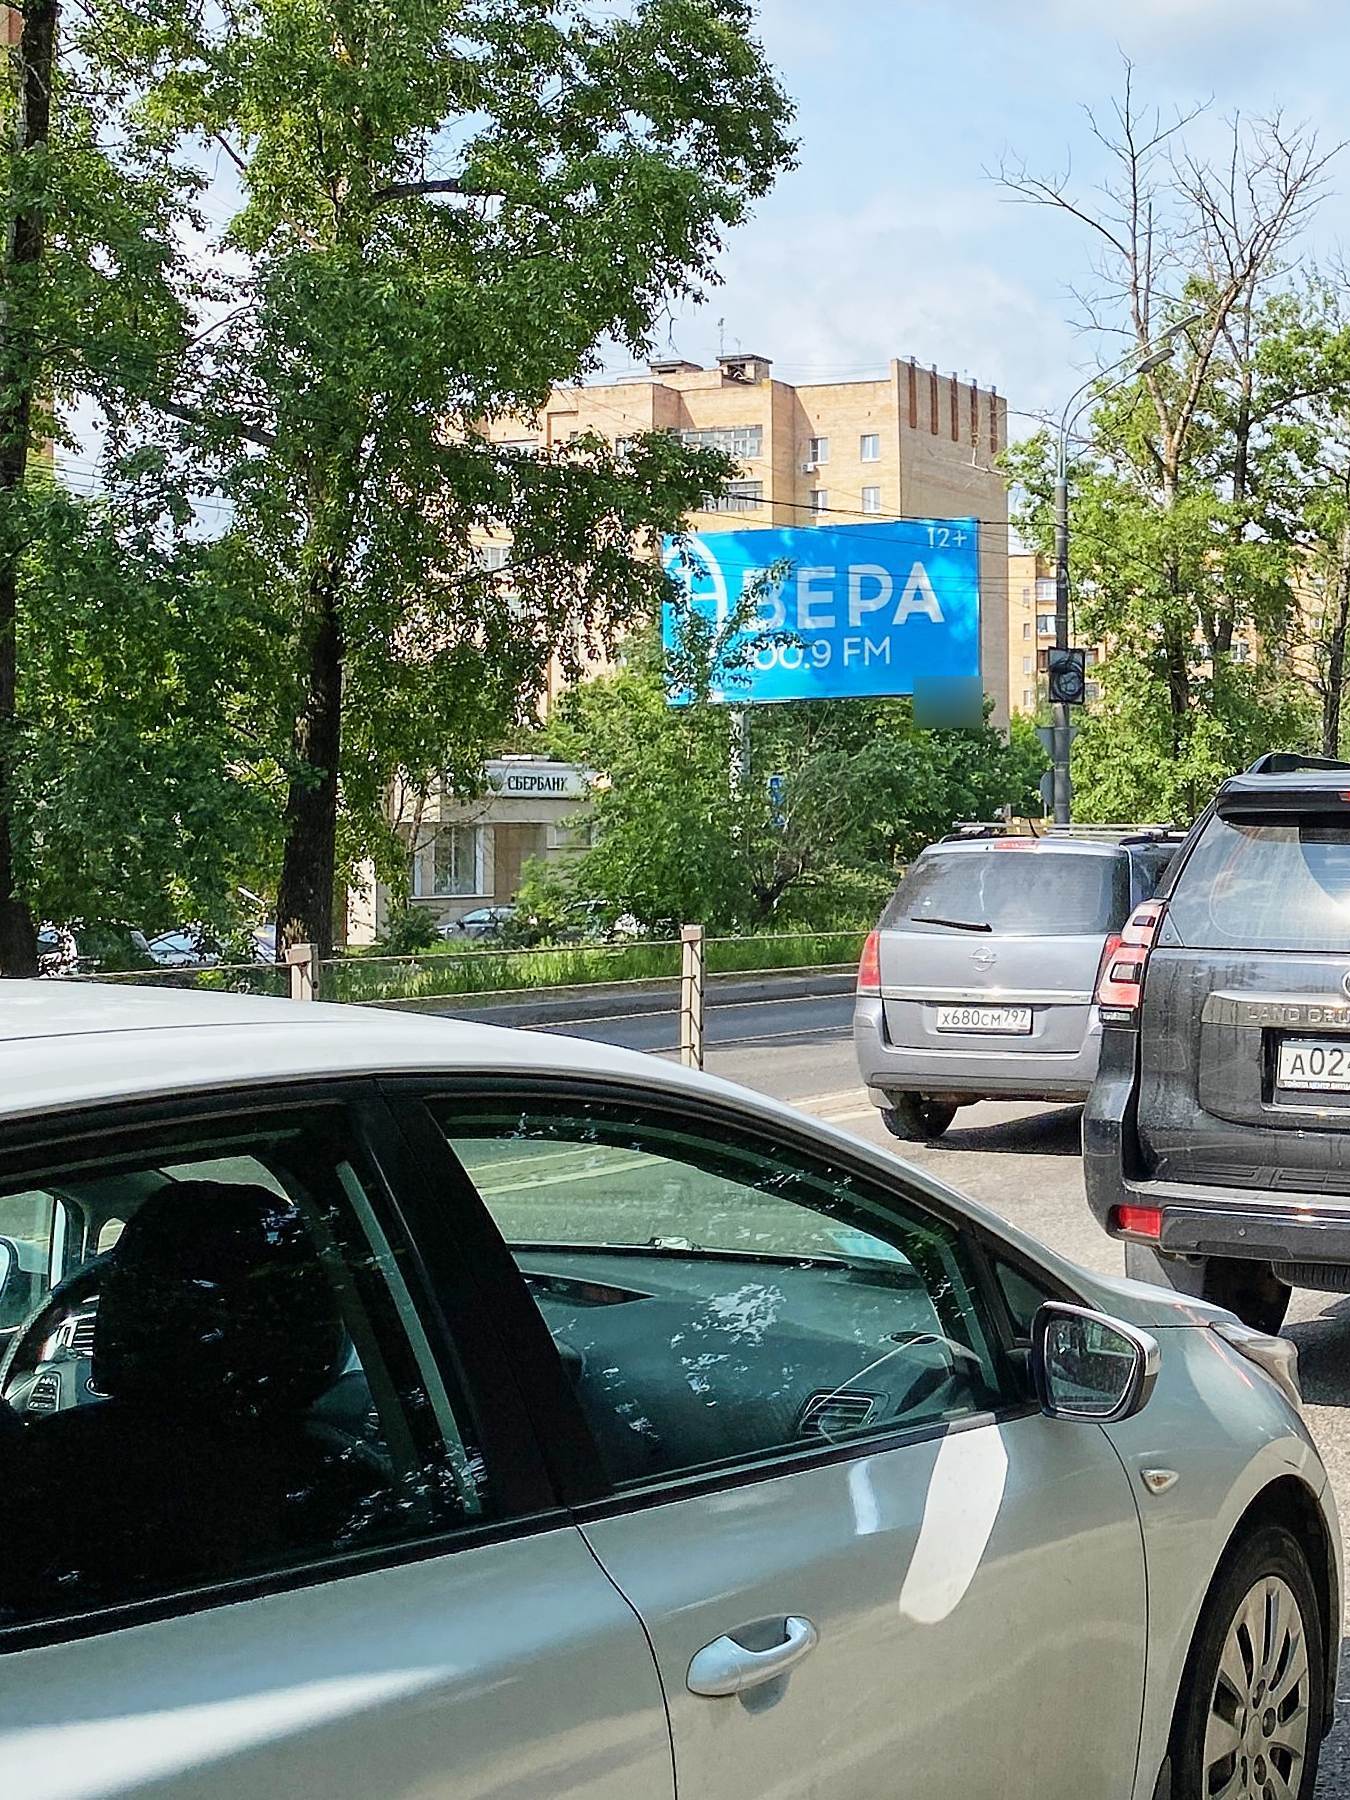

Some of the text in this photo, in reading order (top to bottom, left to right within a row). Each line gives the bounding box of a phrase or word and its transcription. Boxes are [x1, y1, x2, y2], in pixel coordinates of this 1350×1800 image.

[927, 526, 967, 549] 12+
[742, 561, 945, 633] ВЕРА
[744, 636, 891, 671] 00.9 FM
[507, 775, 568, 791] СБЕРБАНК
[1003, 1008, 1027, 1023] 797
[1247, 1005, 1300, 1022] LAND
